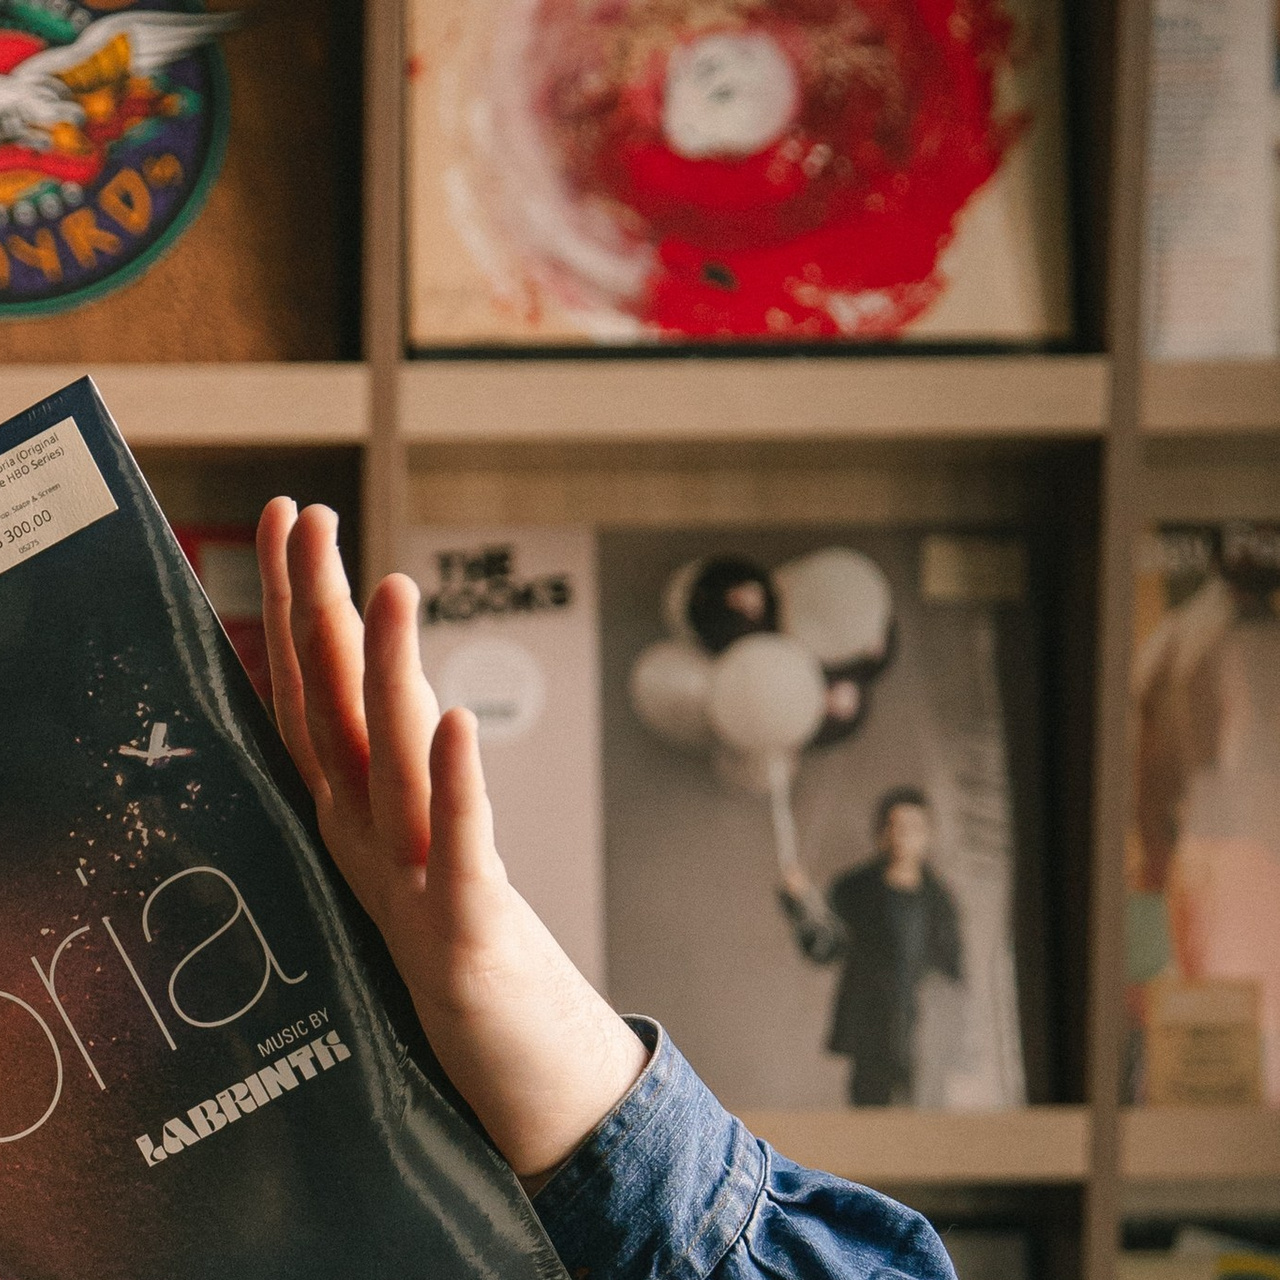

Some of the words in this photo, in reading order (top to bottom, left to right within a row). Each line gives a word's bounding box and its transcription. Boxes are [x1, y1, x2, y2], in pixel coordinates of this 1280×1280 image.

[8, 463, 30, 484] HBO
[30, 446, 65, 471] Series)
[16, 432, 59, 464] (Original
[4, 508, 52, 544] 300,00
[437, 546, 512, 582] THE
[257, 1020, 309, 1057] MUSIC
[309, 1007, 329, 1029] BY
[135, 1029, 352, 1167] LABRINTH
